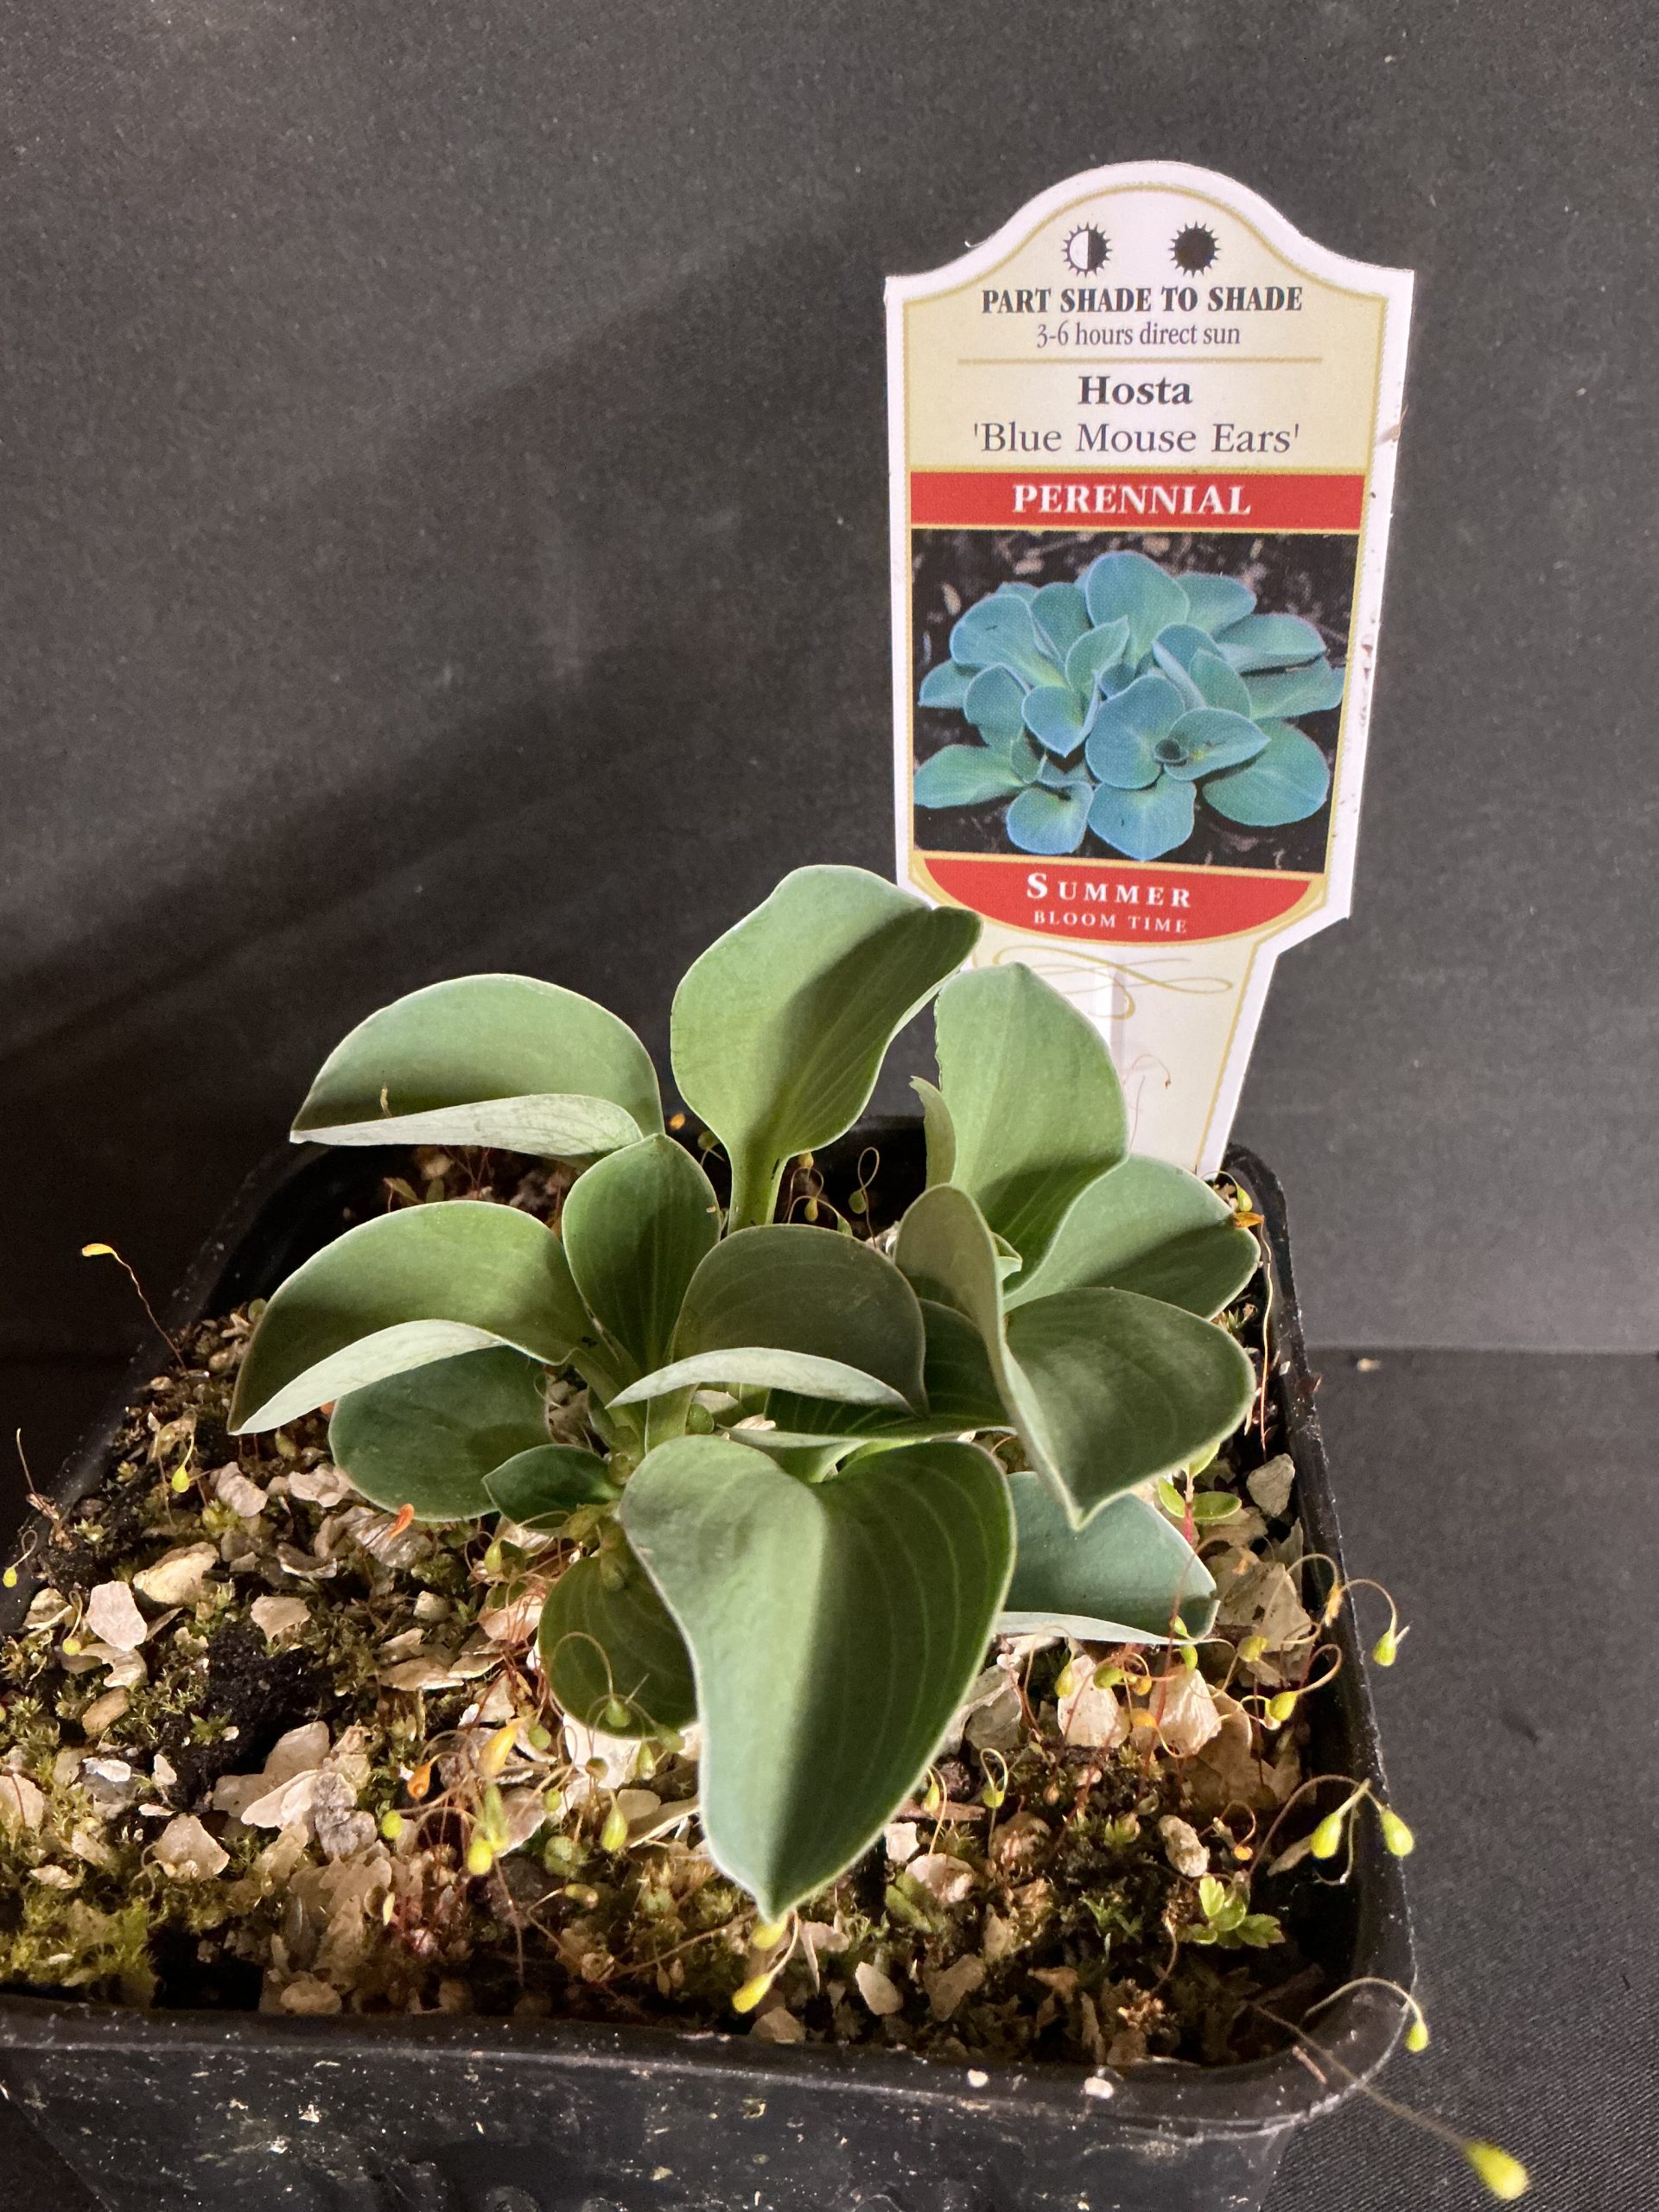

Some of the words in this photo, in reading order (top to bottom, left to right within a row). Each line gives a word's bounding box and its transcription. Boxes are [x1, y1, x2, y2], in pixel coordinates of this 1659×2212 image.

[982, 289, 1052, 314] PART
[1060, 288, 1152, 313] SHADE
[1160, 288, 1198, 312] TO
[1207, 286, 1303, 312] SHADE
[1036, 321, 1069, 349] 3-6
[1075, 322, 1134, 346] hours
[1139, 321, 1198, 345] direct
[1202, 326, 1241, 345] sun
[1077, 376, 1192, 406] Hosta
[974, 422, 1062, 453] 'Blue
[1076, 423, 1197, 453] Mouse
[1211, 423, 1300, 453] Ears'
[1013, 484, 1251, 515] PERENNIAL
[1027, 872, 1192, 908] SUMMER
[1033, 910, 1117, 929] BLOOM
[1128, 915, 1188, 934] TIME
